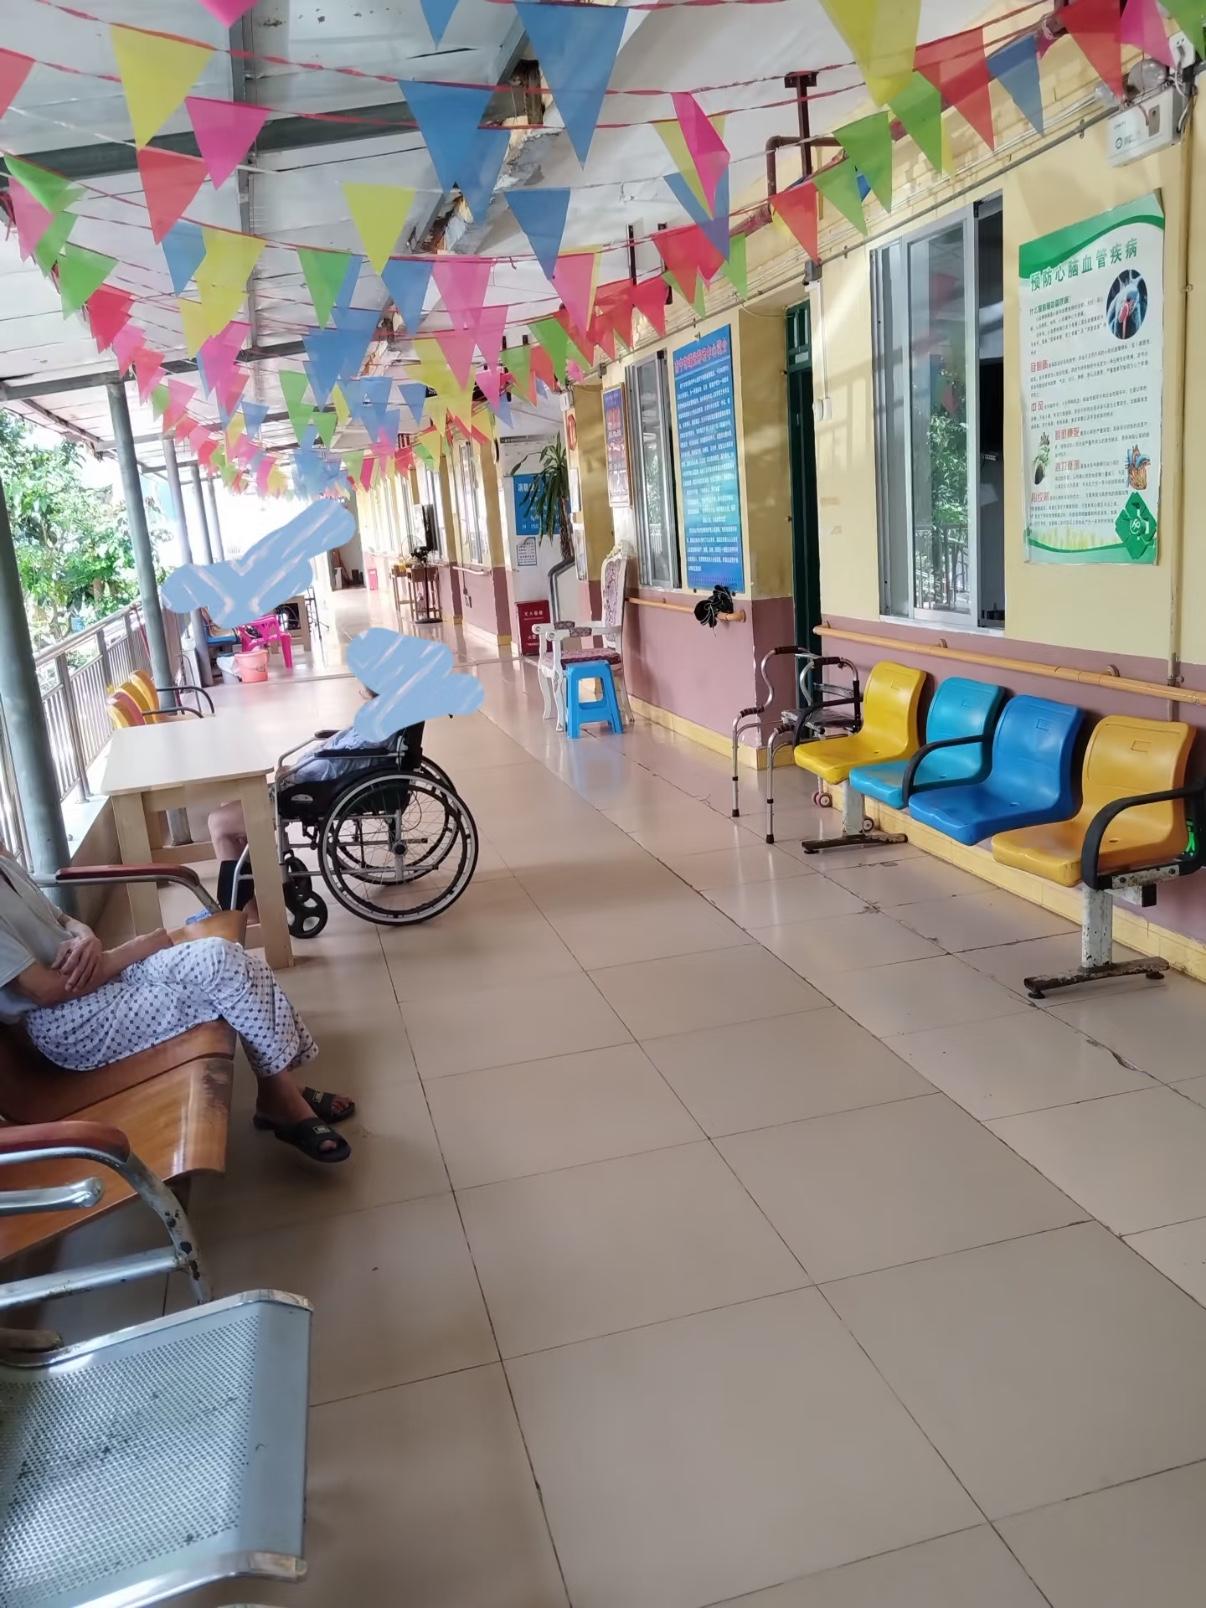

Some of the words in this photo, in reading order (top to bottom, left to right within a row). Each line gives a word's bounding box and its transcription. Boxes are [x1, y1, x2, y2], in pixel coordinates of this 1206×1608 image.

[1030, 238, 1138, 292] 预防心脑血管疾病
